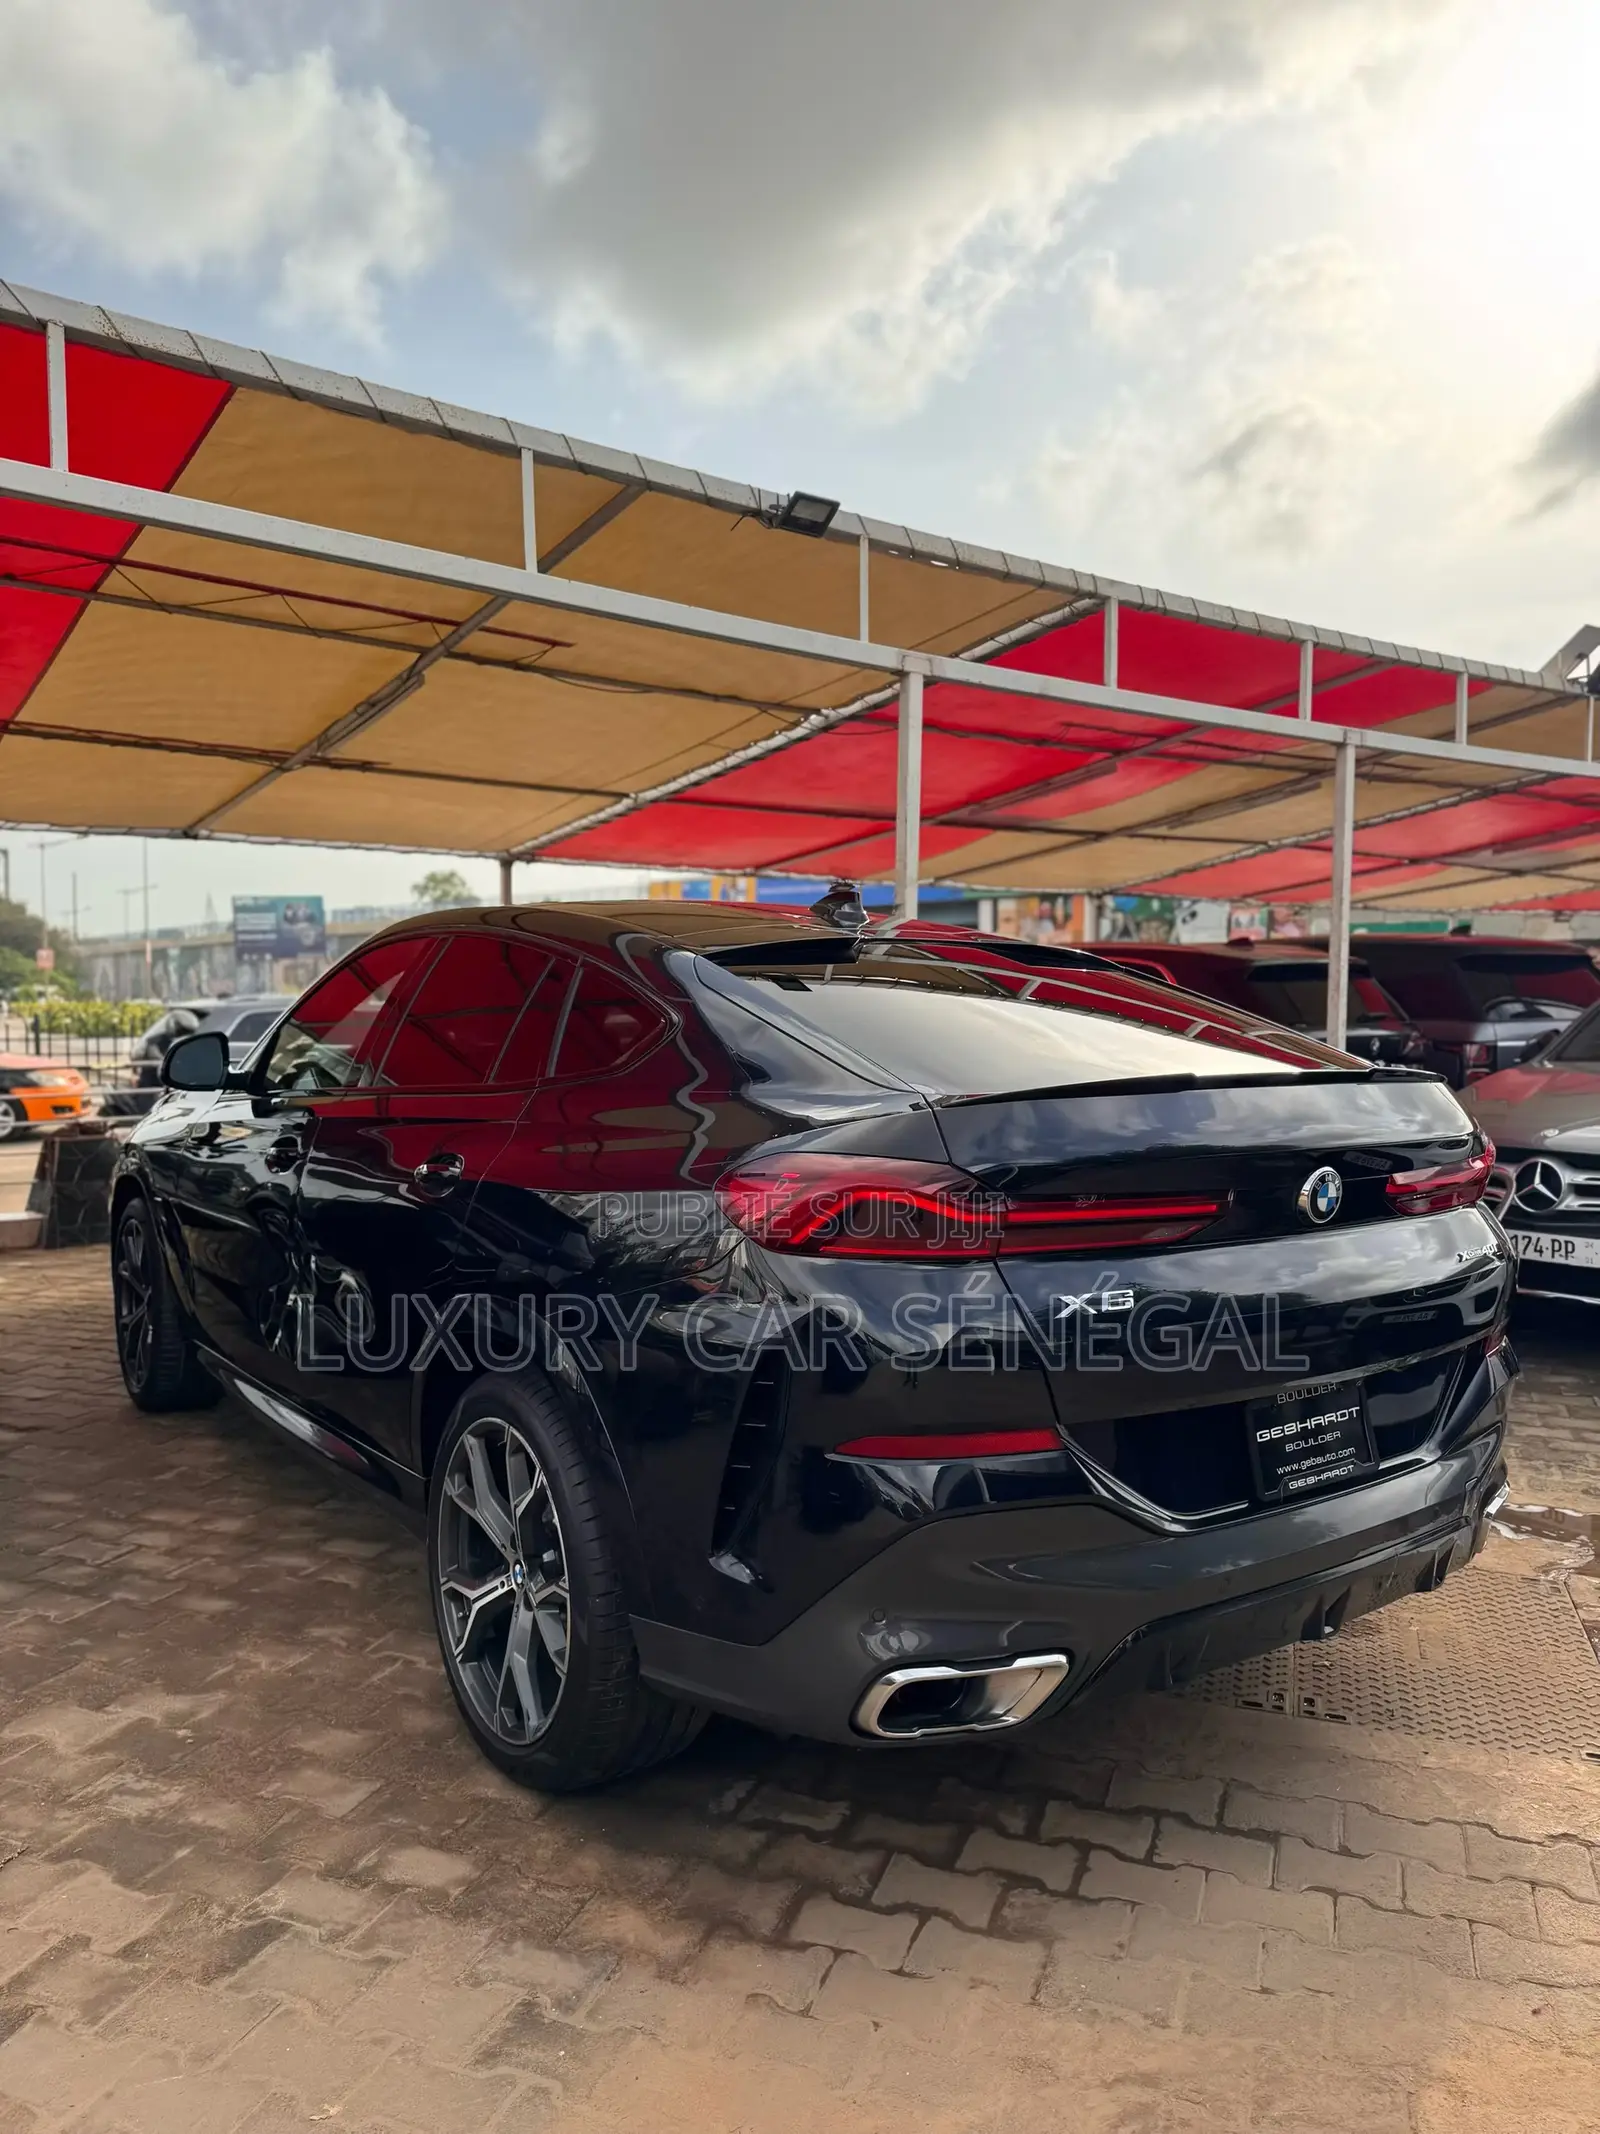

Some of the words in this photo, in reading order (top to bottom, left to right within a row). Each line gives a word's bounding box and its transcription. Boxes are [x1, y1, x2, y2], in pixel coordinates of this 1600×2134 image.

[1313, 1172, 1341, 1191] BMW
[1054, 1289, 1135, 1319] X6
[1276, 1382, 1337, 1404] BOULDER
[1256, 1406, 1360, 1442] GEBHARDT
[1285, 1430, 1342, 1452] BOULDER
[1276, 1447, 1356, 1475] www.gebauto.com
[1288, 1464, 1354, 1489] GEBHARDT
